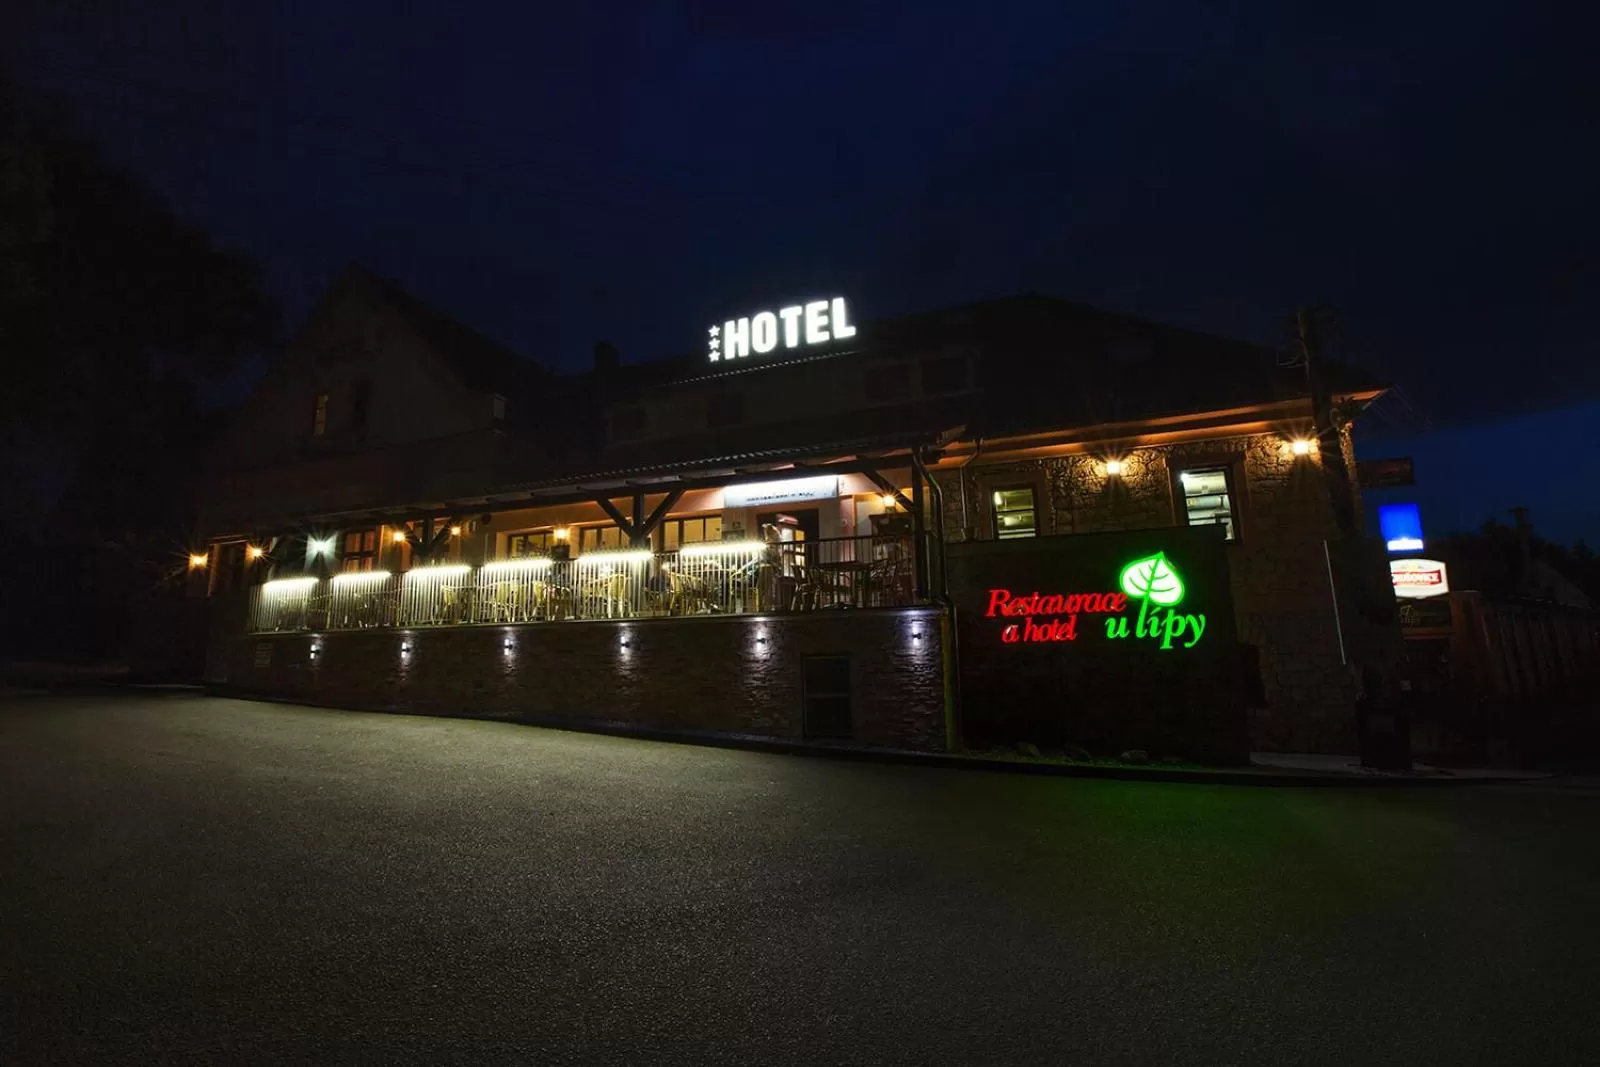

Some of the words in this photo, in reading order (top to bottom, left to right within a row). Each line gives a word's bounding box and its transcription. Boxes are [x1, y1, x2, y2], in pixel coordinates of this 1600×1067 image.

[723, 297, 857, 360] HOTEL
[986, 589, 1128, 616] Restaurace
[1002, 624, 1020, 643] a
[1023, 615, 1077, 642] hotel
[1105, 616, 1130, 638] u
[1136, 602, 1206, 650] lípy
